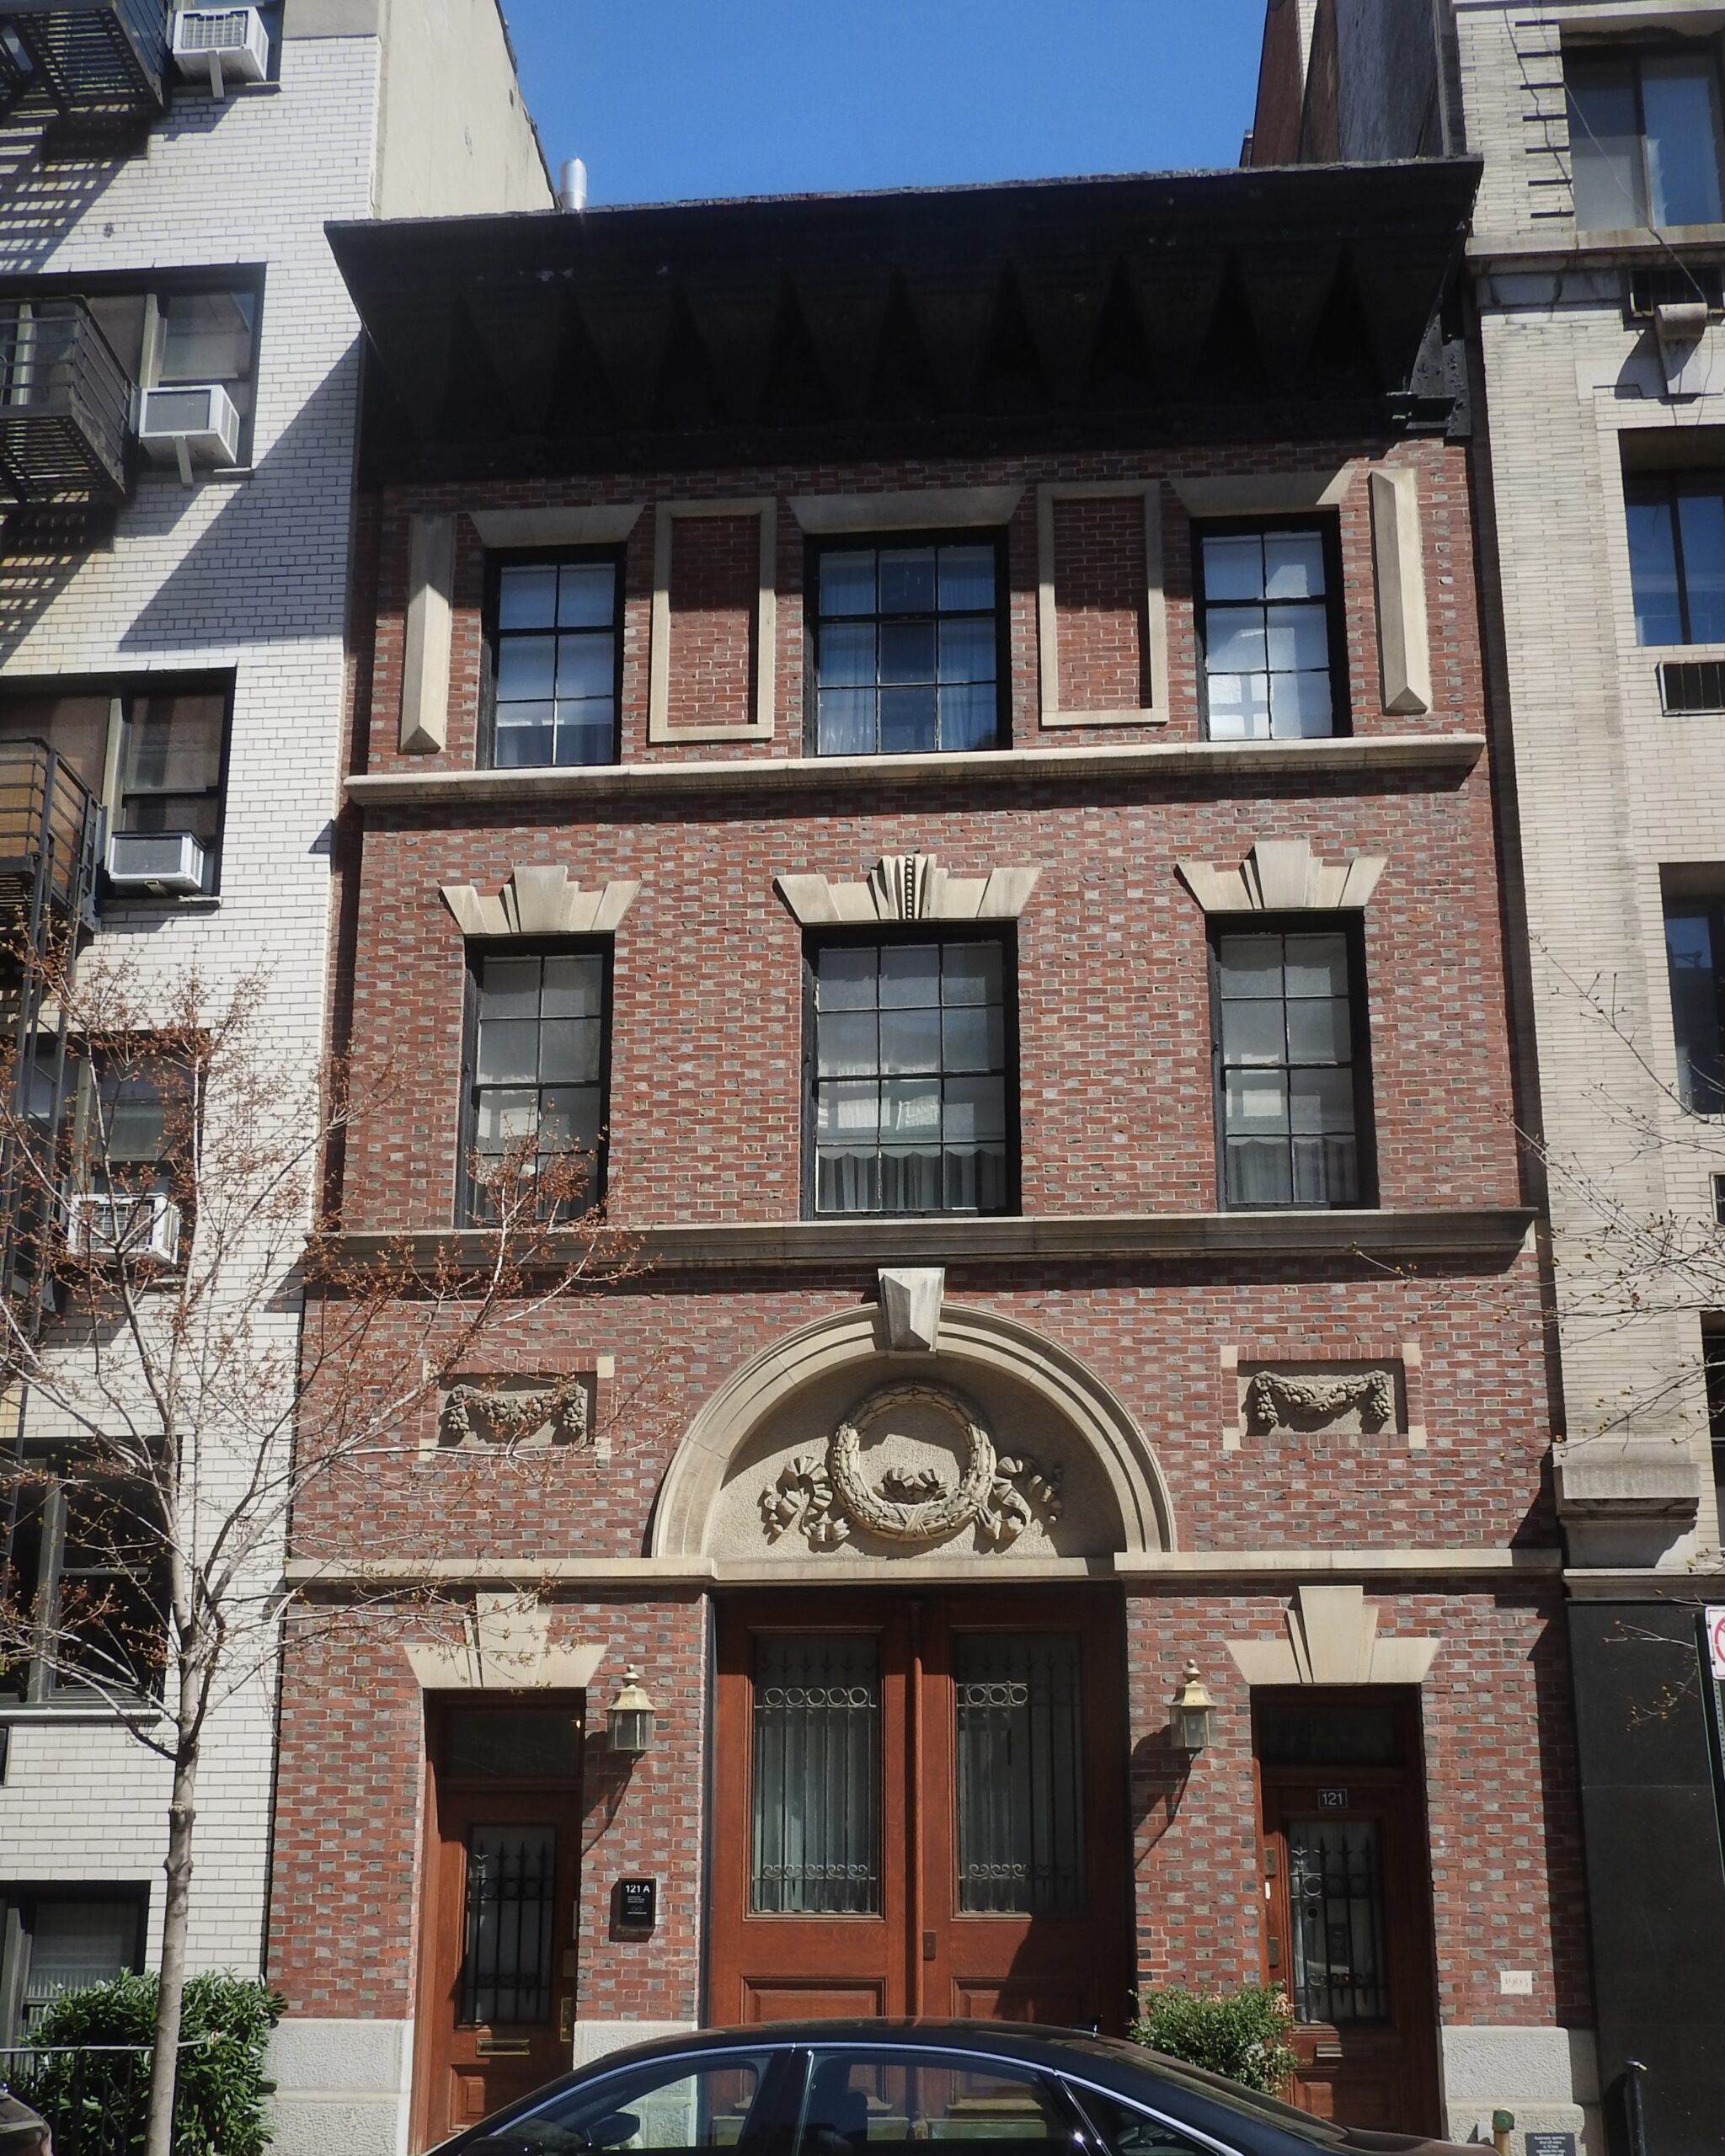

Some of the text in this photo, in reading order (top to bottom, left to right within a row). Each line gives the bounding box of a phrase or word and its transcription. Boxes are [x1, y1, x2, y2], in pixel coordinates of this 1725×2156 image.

[1322, 1792, 1343, 1806] 121
[625, 1884, 650, 1893] 121 A
